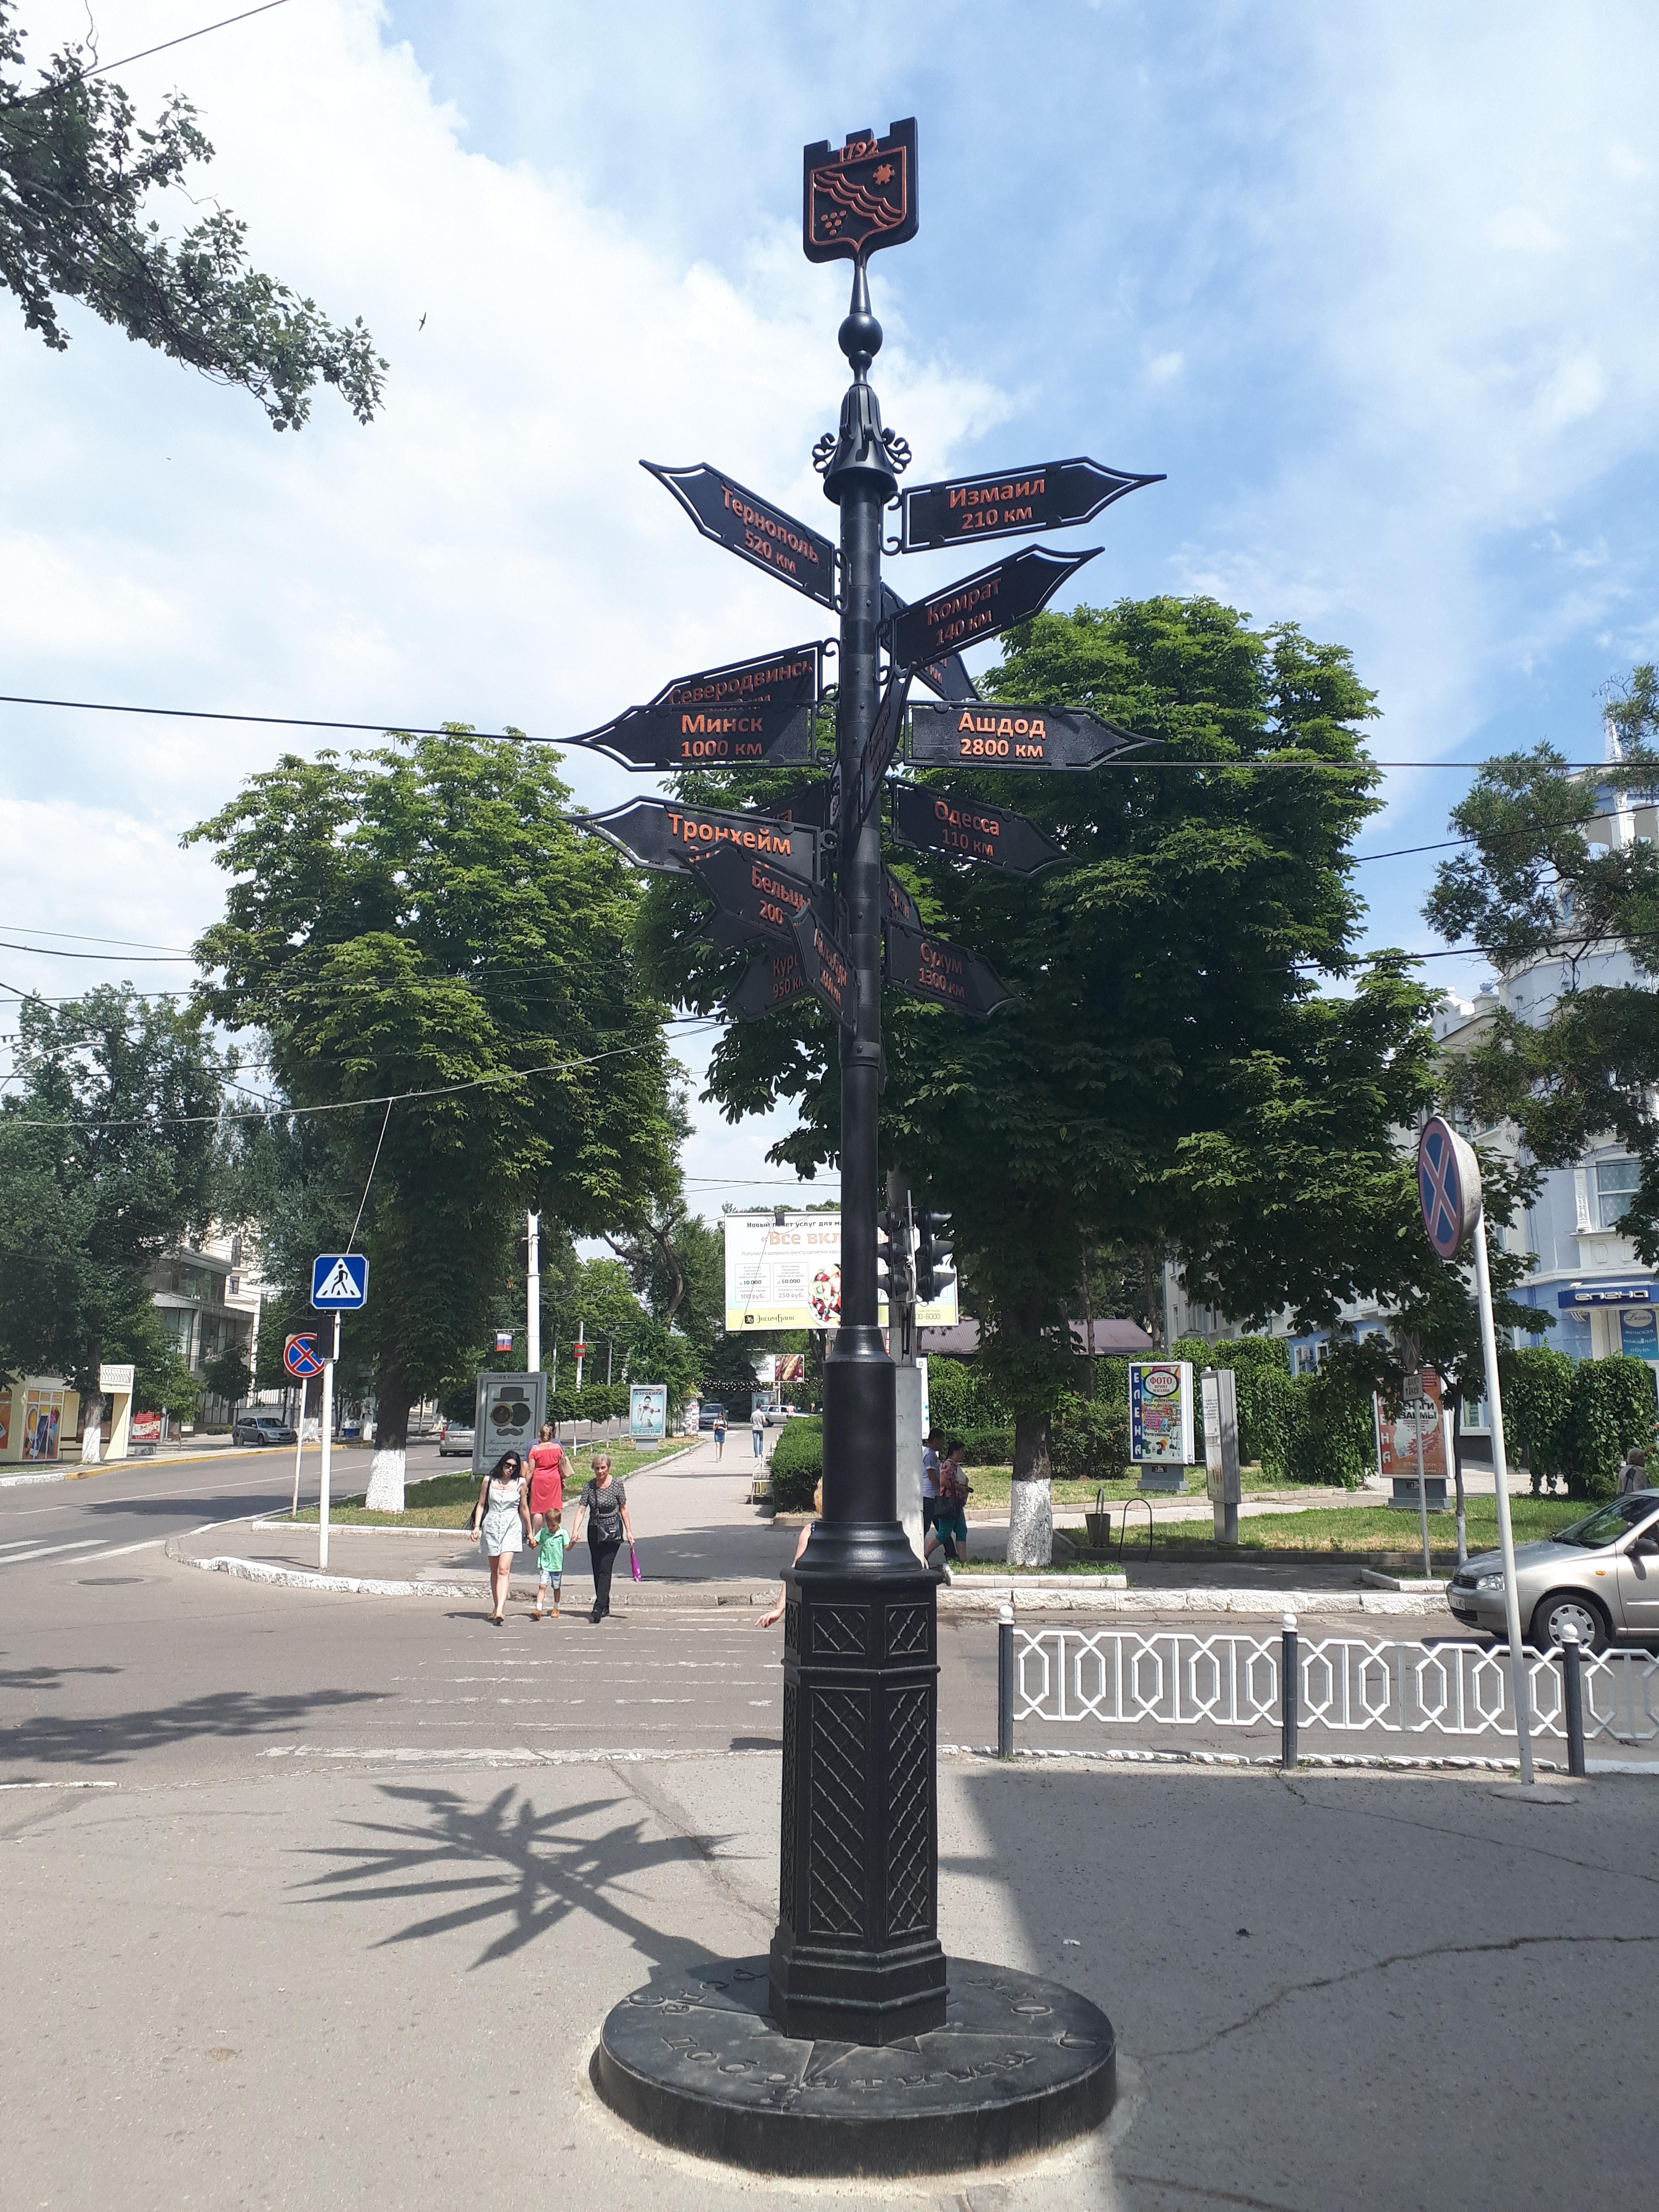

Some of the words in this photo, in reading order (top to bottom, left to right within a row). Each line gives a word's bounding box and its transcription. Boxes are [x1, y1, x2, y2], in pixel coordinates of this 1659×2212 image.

[839, 139, 879, 162] 1792
[949, 479, 1045, 508] Измаил
[721, 485, 820, 565] Тернополь
[962, 509, 998, 530] 210
[1004, 506, 1033, 523] км
[745, 529, 772, 560] 520
[776, 552, 796, 575] км
[927, 577, 1002, 626] Комрат
[937, 619, 965, 646] 140
[969, 610, 992, 632] км
[669, 661, 813, 704] Северодвинск
[681, 714, 764, 733] Минск
[958, 712, 1046, 740] Ашдод
[681, 740, 729, 757] 1000
[735, 743, 763, 756] км
[961, 738, 1009, 756] 2800
[1015, 744, 1044, 758] км
[935, 801, 1000, 836] Одесса
[668, 813, 792, 855] Тронхейм
[942, 829, 969, 849] 110
[973, 841, 994, 857] км
[752, 866, 811, 912] Бельцы
[759, 900, 784, 926] 200
[920, 942, 962, 975] Сухум
[773, 977, 791, 999] 950
[919, 967, 947, 991] 1300
[949, 982, 965, 998] км
[1150, 1377, 1172, 1385] ФОТО
